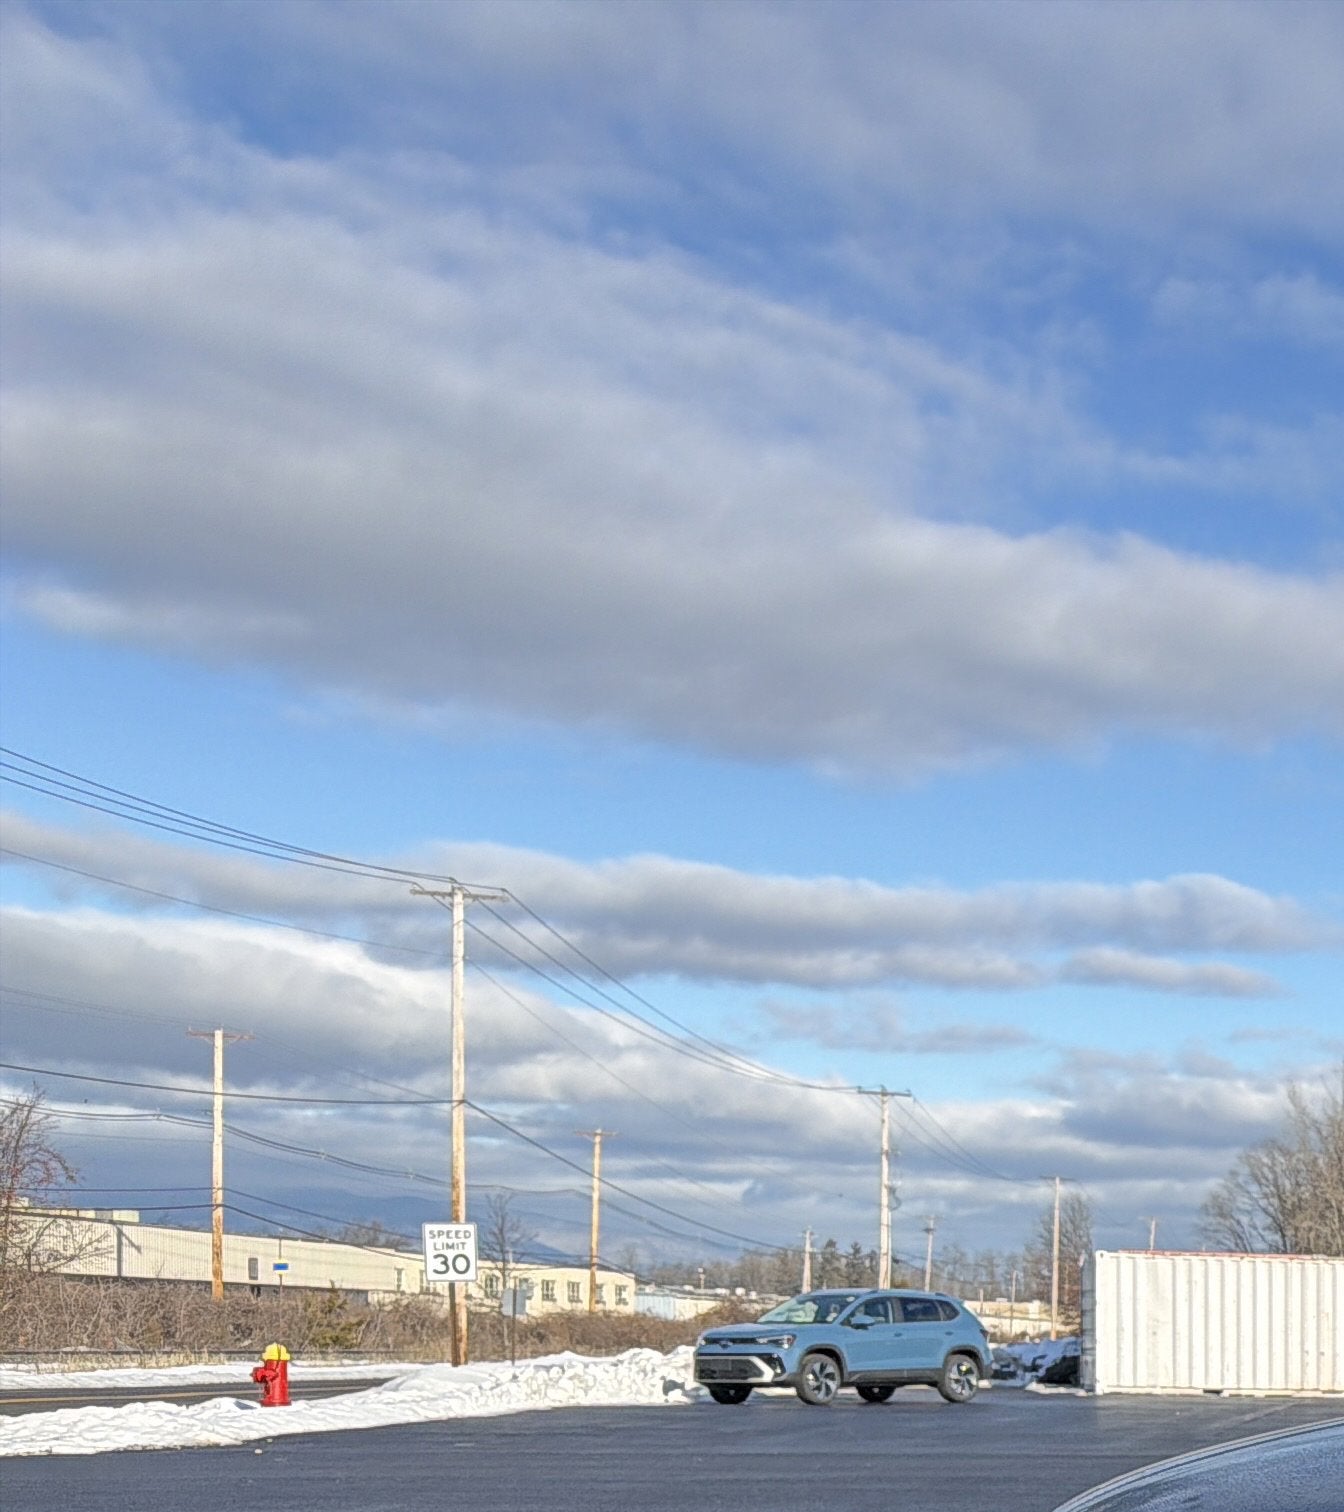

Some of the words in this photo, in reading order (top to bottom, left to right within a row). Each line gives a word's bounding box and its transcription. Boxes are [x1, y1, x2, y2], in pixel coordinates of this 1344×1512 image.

[428, 1229, 472, 1240] SPEED
[433, 1241, 467, 1251] LIMIT
[432, 1253, 471, 1275] 30
